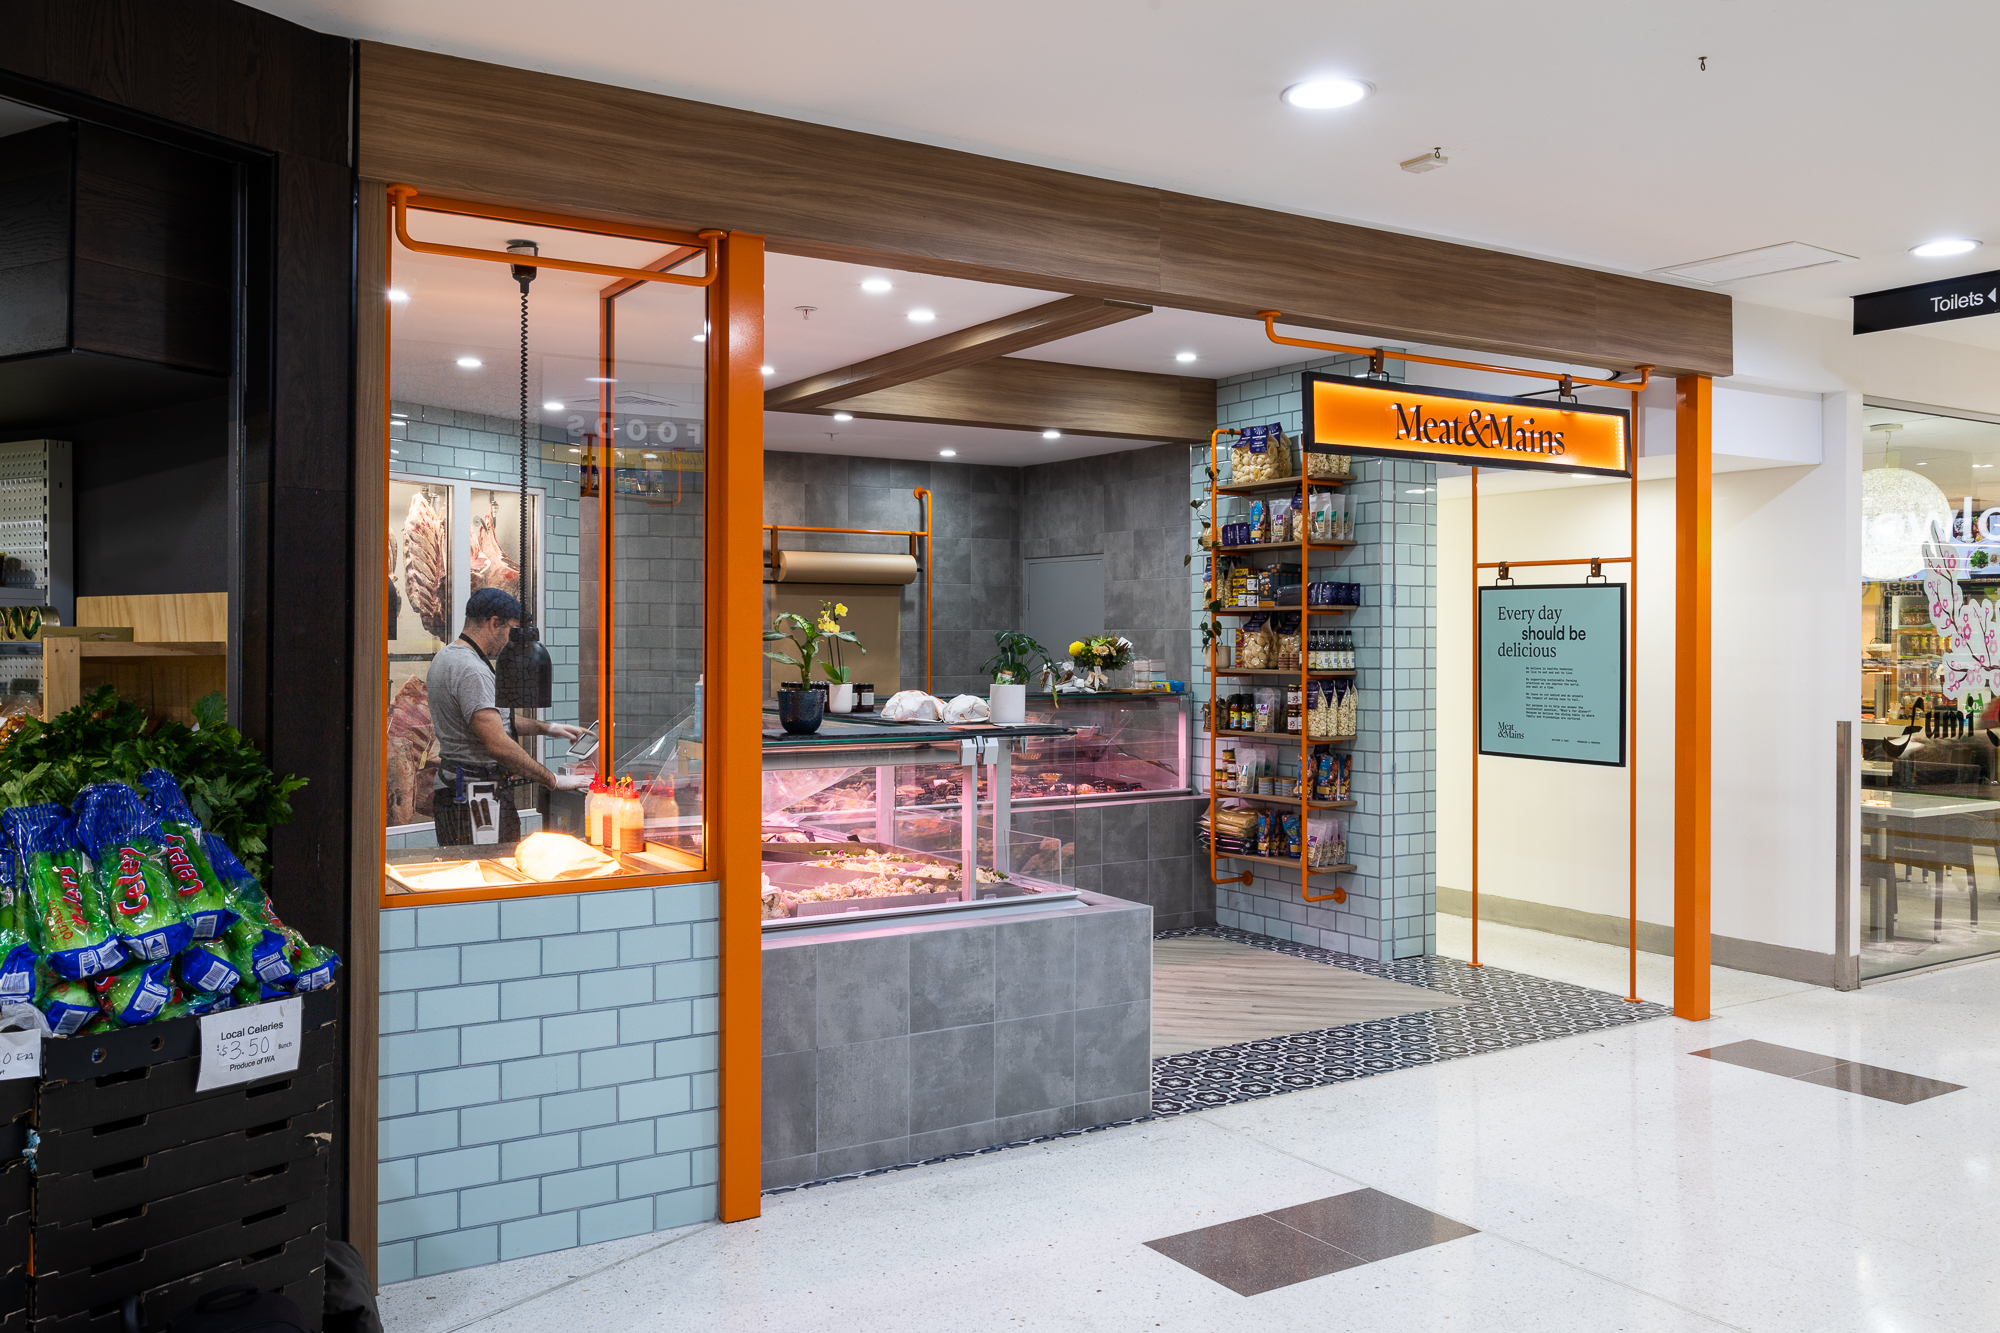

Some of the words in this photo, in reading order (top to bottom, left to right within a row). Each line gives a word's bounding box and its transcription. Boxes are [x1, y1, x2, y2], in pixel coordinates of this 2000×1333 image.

[1930, 291, 1984, 313] Toilets
[1394, 401, 1566, 456] Meat&Mains
[1498, 606, 1535, 624] Every
[1538, 605, 1562, 624] day
[1522, 625, 1565, 640] should
[1569, 625, 1586, 640] be
[1498, 642, 1557, 658] delicious
[1498, 722, 1514, 731] Meat
[1498, 729, 1524, 740] &Mains
[164, 833, 204, 898] Celery
[115, 847, 150, 915] Celery
[221, 1028, 245, 1041] Local
[247, 1021, 284, 1035] Celeries
[278, 1041, 292, 1050] Bunch
[229, 1060, 256, 1072] Produce
[256, 1058, 263, 1066] of
[264, 1055, 276, 1064] WA
